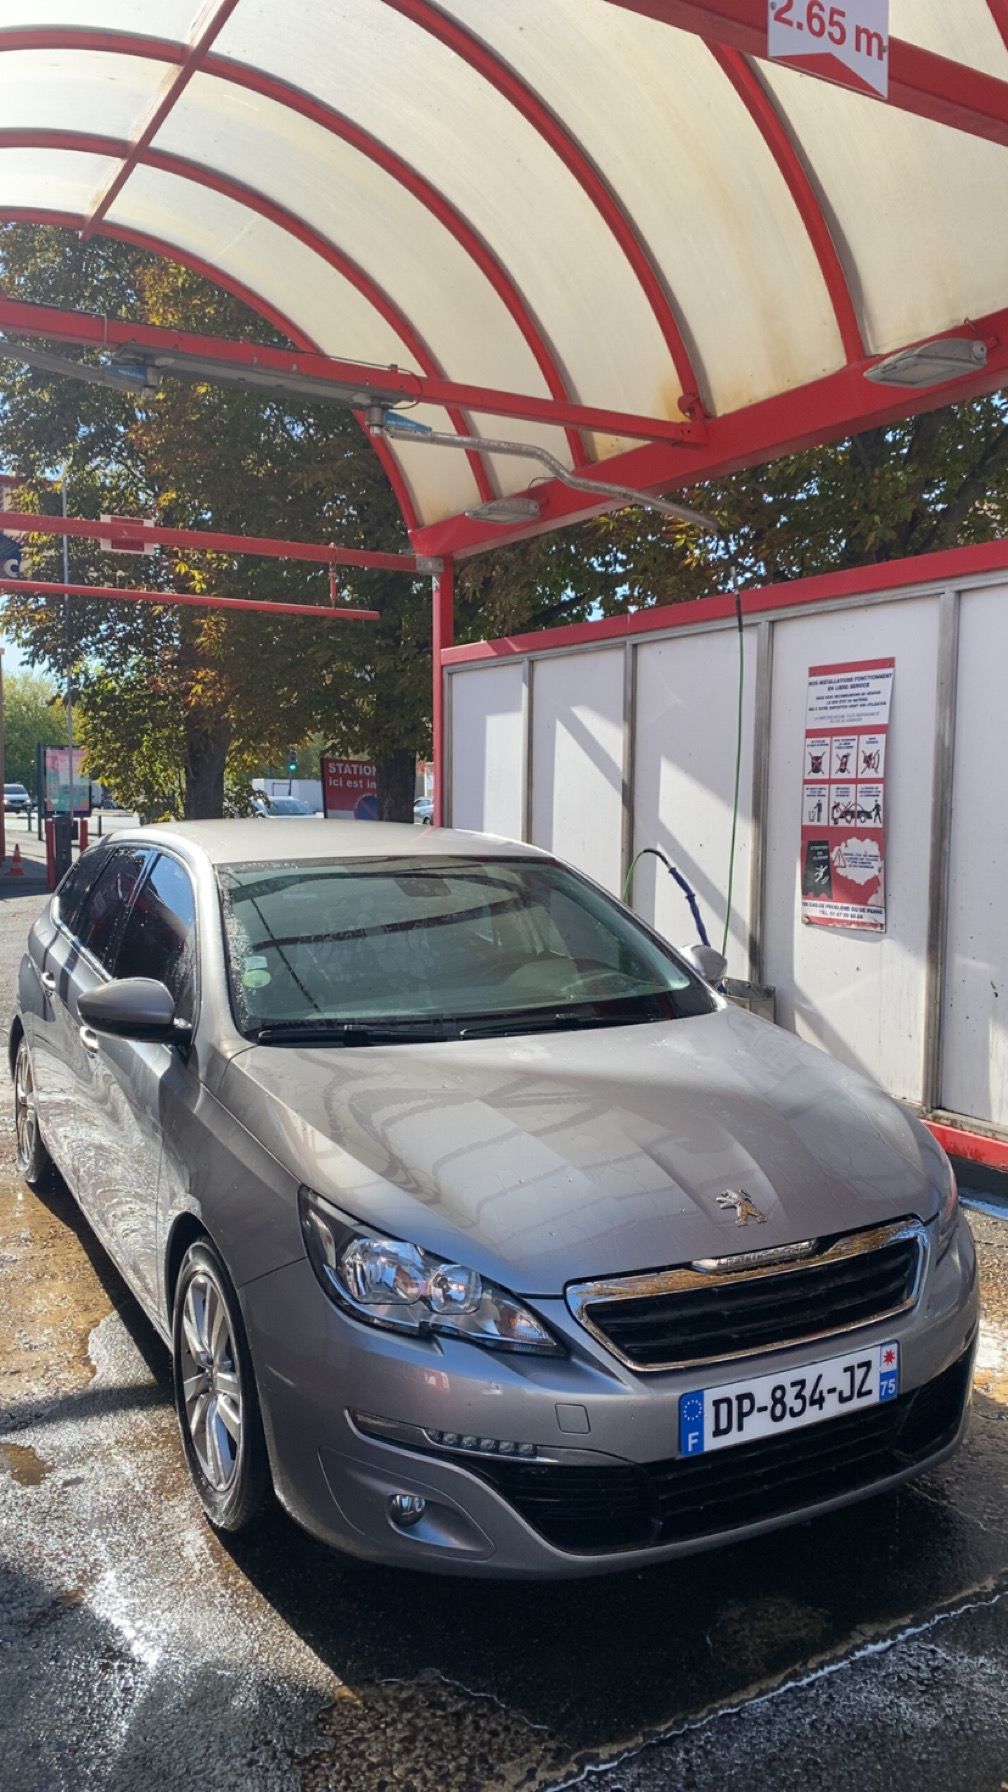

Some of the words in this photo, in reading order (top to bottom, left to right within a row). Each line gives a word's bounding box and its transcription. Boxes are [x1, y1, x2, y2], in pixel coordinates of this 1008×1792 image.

[773, 0, 847, 46] 2.65
[855, 24, 884, 61] m
[328, 777, 343, 787] ici
[346, 780, 363, 789] est
[880, 1377, 896, 1397] 75
[711, 1359, 873, 1438] DP-834-JZ
[687, 1431, 699, 1452] F
